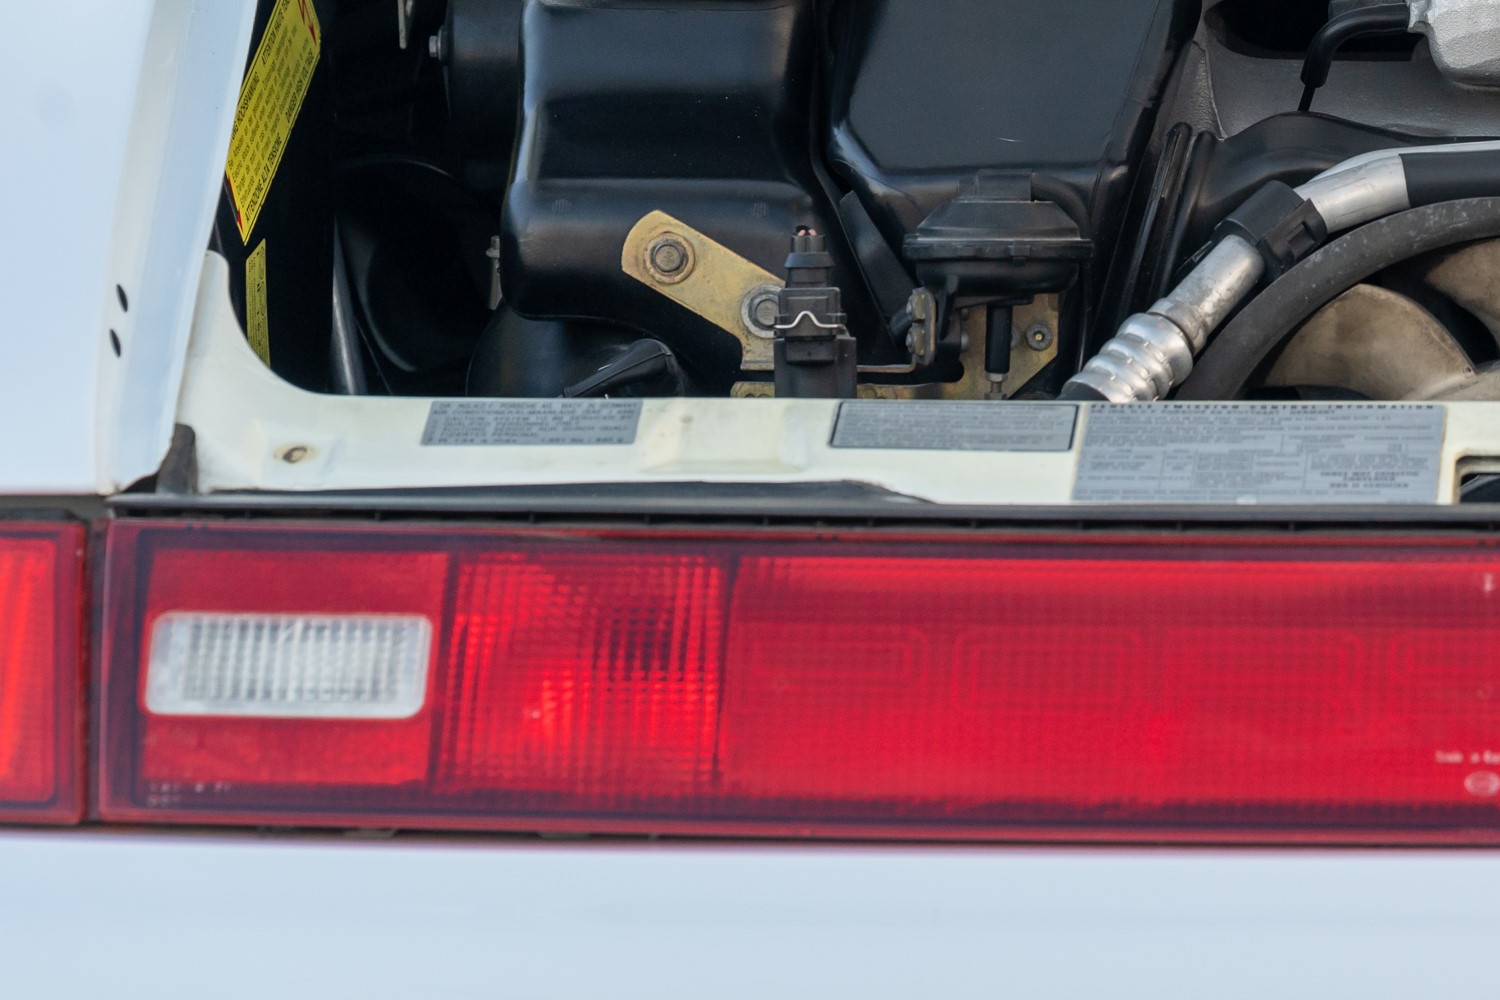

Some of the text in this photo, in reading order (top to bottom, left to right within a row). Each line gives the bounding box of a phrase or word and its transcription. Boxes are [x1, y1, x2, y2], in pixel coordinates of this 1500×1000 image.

[245, 131, 282, 222] ATTENZIONE ALTA TENSIONE
